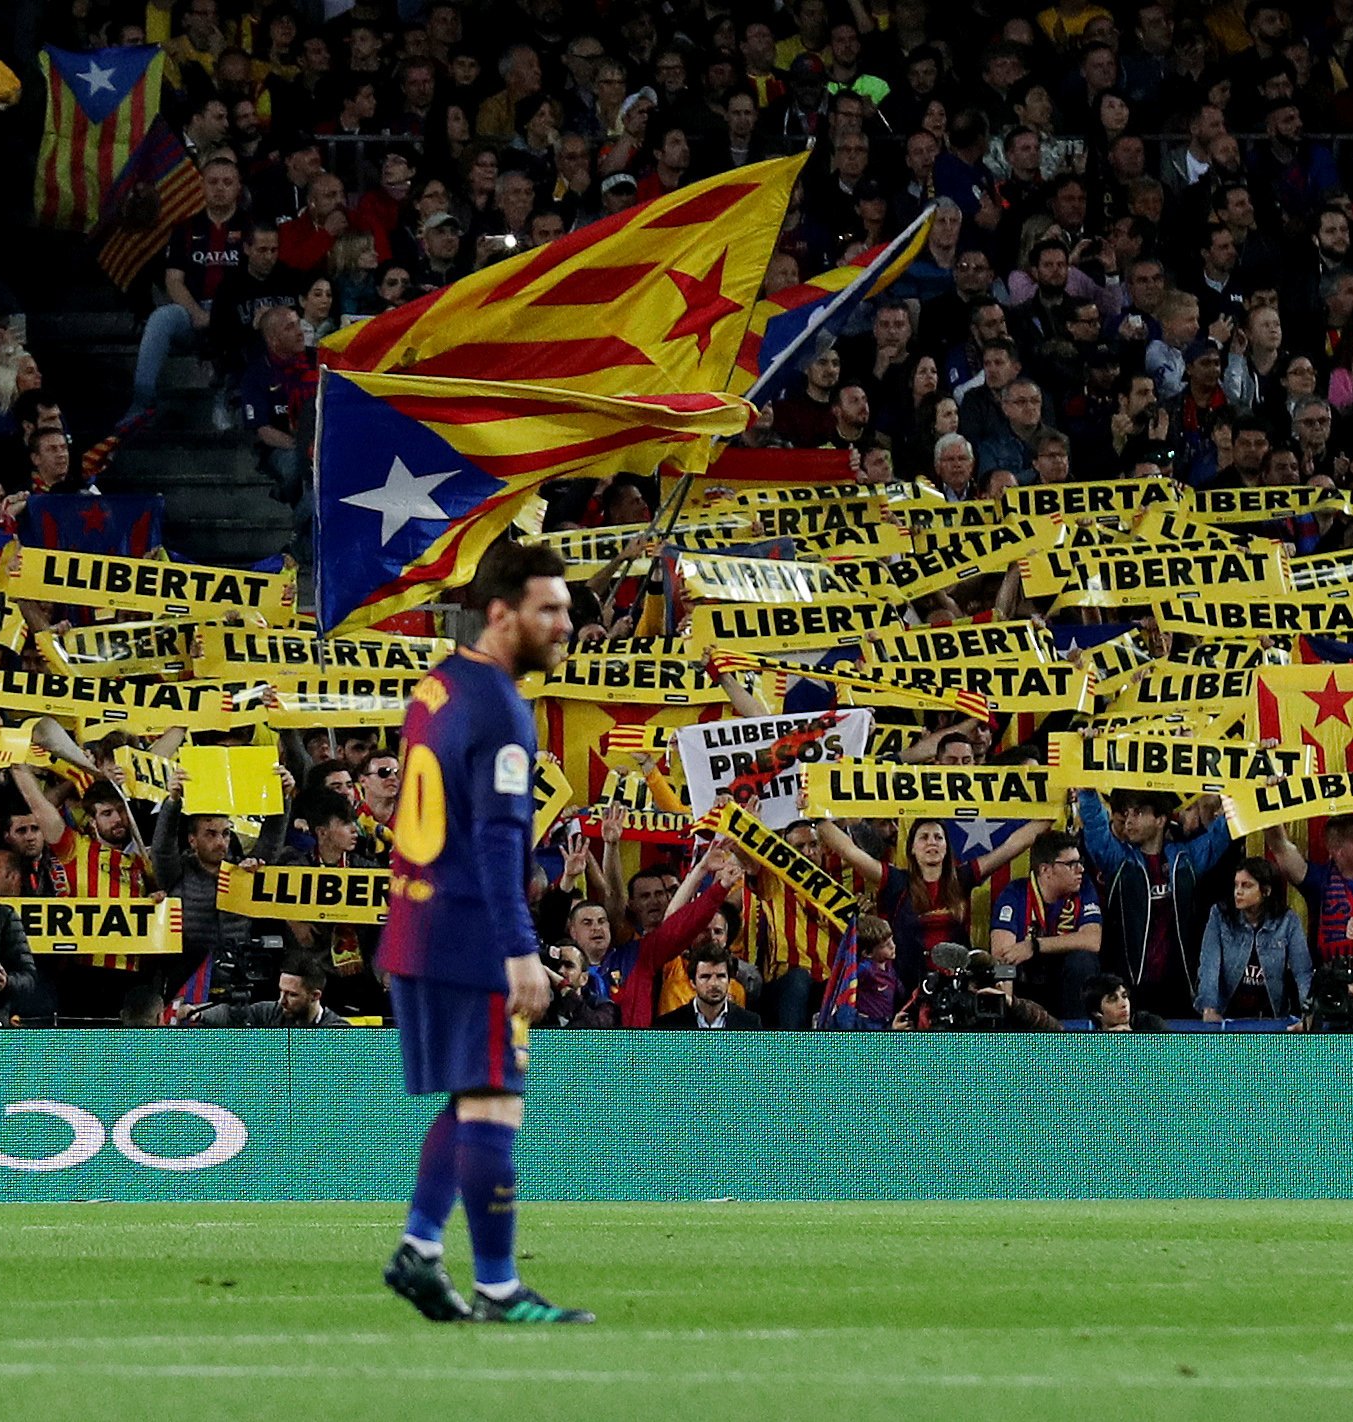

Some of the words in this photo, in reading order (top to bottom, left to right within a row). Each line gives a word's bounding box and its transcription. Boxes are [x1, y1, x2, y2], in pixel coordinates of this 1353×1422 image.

[192, 250, 240, 264] QATAR
[1002, 483, 1170, 518] LIBERTA
[1189, 488, 1345, 513] IBERTA
[758, 502, 868, 537] ERTAT
[889, 520, 1035, 588] BERTA
[44, 555, 269, 606] LLIBERTAT
[712, 602, 904, 639] LLIBERTA
[1160, 602, 1353, 630] LLIBERTA
[58, 622, 198, 664] LLIBERT
[224, 632, 433, 670] LLIBERTAT
[874, 625, 1029, 663] LLIBERT
[545, 660, 752, 691] LLIBERT
[1137, 671, 1253, 703] LLIBE
[709, 734, 844, 780] PRESOS
[1083, 736, 1300, 779] LLIBERTAT
[830, 770, 1048, 802] LLIBERTAT
[393, 744, 445, 866] 0
[726, 811, 860, 924] LLIBERTA
[251, 872, 391, 907] LLIBER
[21, 904, 155, 937] ERTAT
